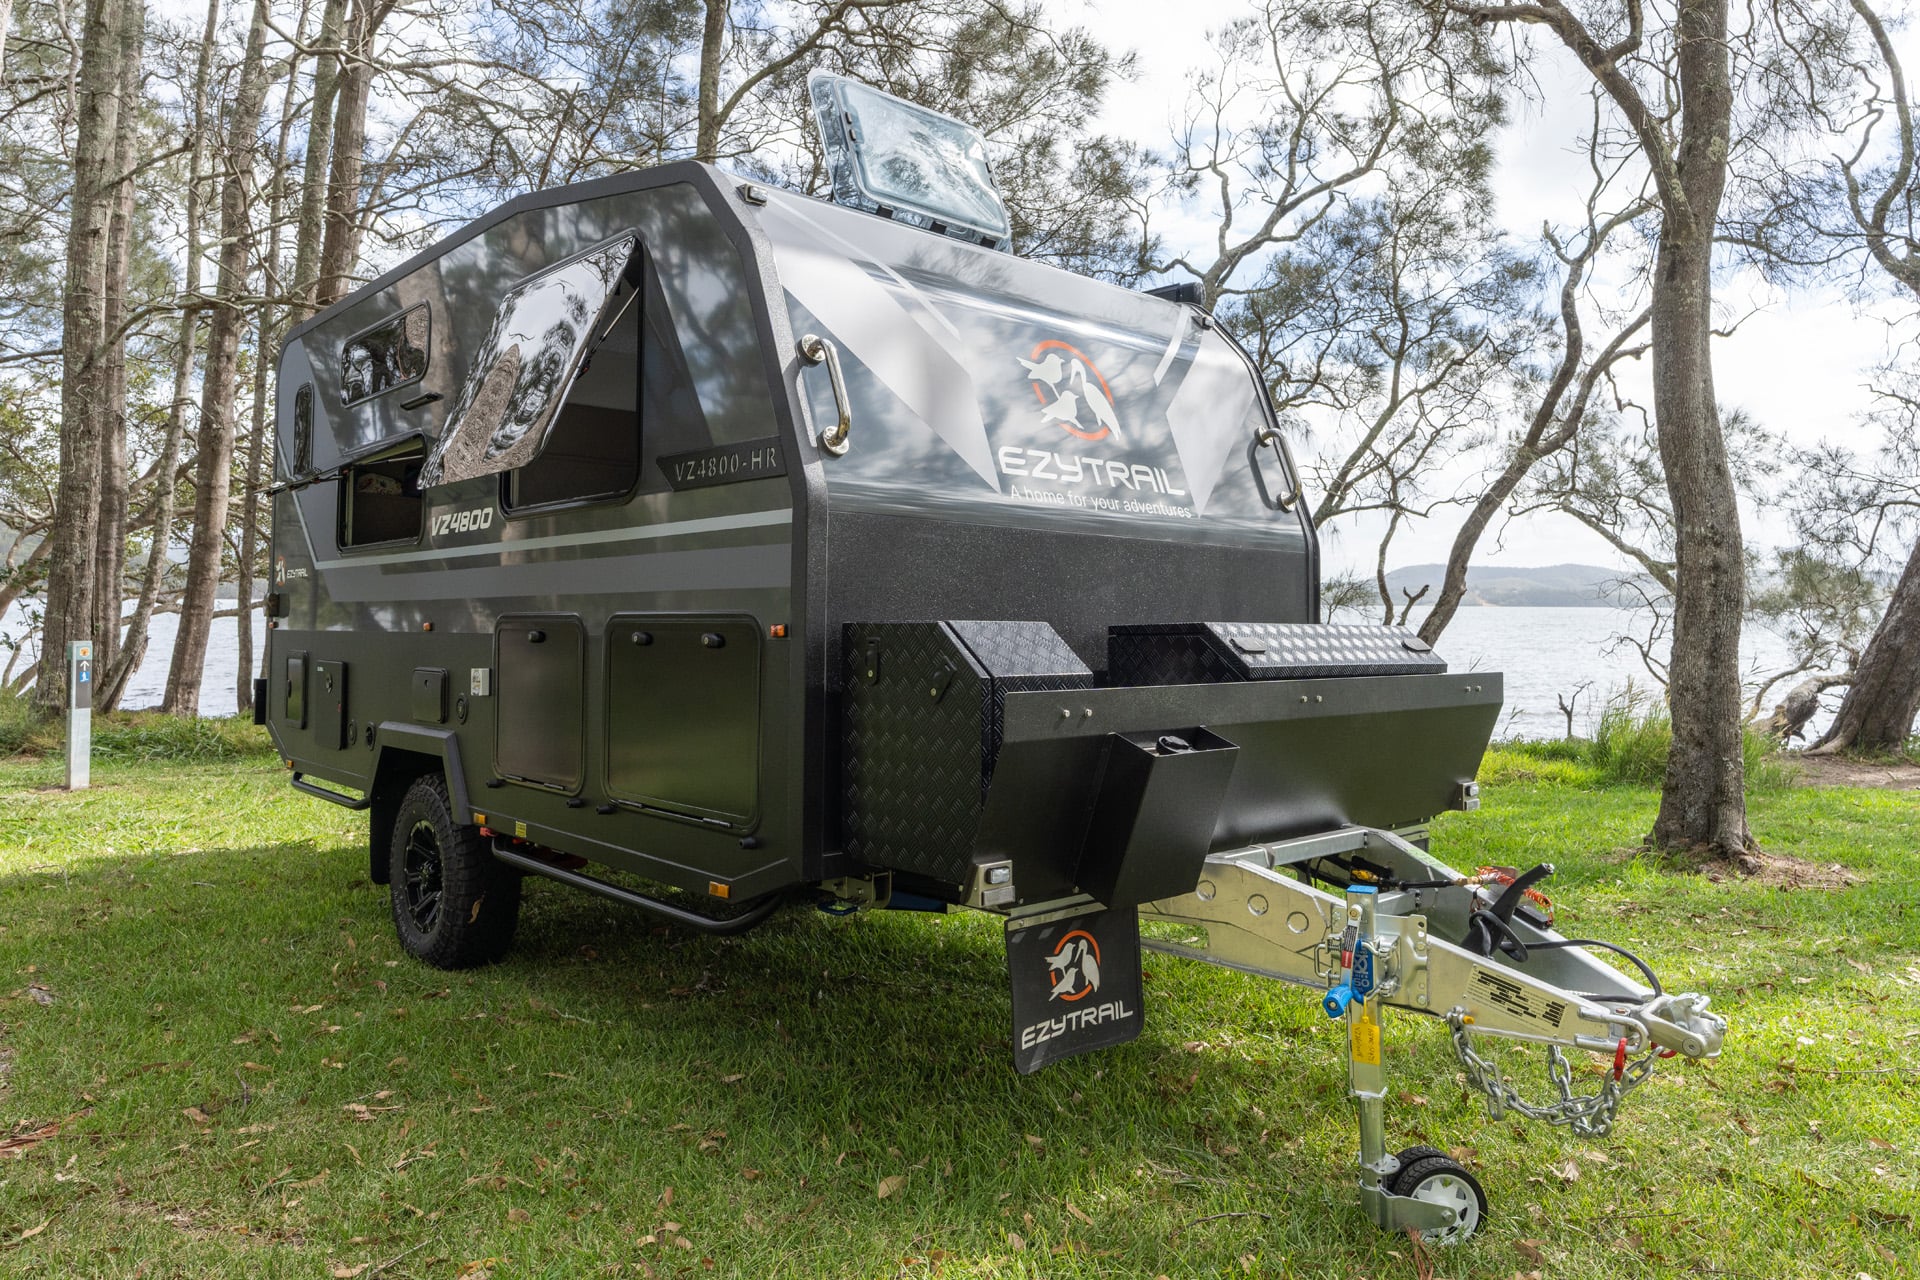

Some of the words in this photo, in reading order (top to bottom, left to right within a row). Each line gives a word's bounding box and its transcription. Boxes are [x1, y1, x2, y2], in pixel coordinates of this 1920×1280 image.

[675, 447, 777, 481] VZ4800-HR
[998, 446, 1186, 496] EZYTRAIL
[1010, 484, 1021, 499] A
[1023, 486, 1064, 505] home
[1067, 490, 1087, 507] for
[1091, 496, 1120, 512] your
[1123, 498, 1192, 519] adventures
[431, 507, 494, 537] VZ4800
[1021, 1000, 1134, 1051] EZYTRAIL
